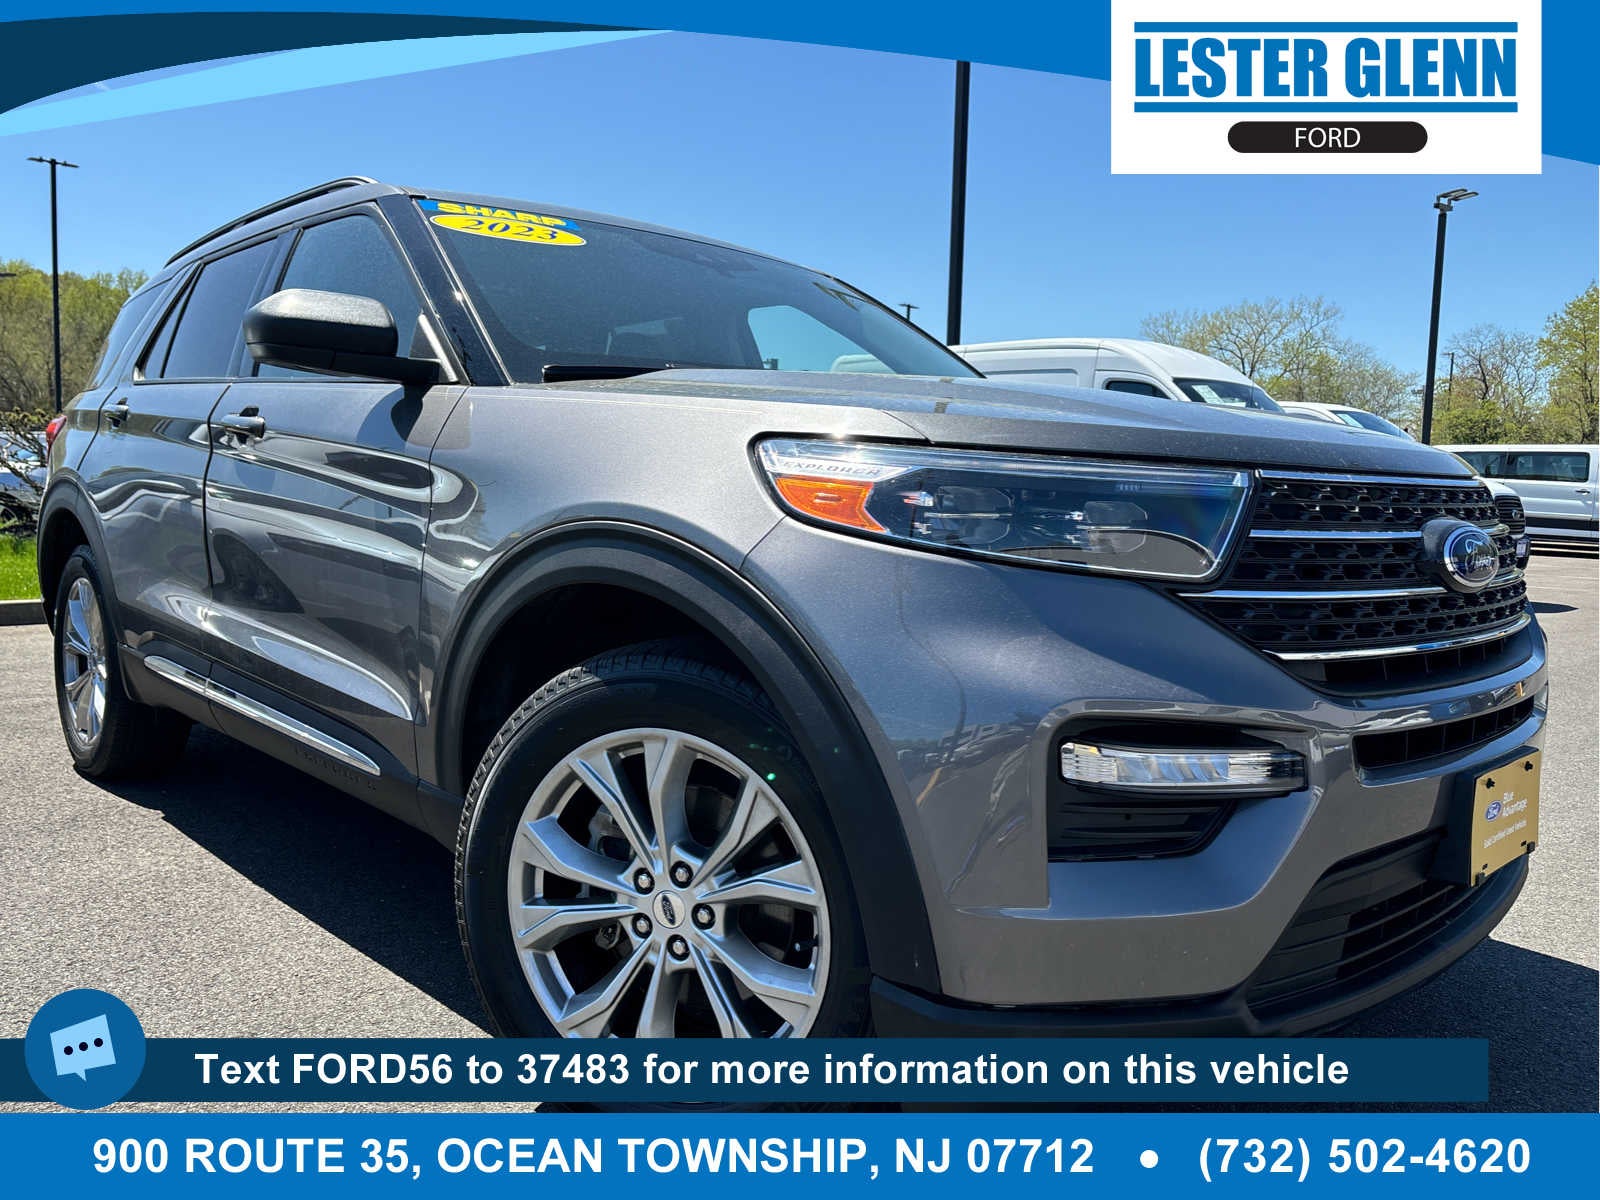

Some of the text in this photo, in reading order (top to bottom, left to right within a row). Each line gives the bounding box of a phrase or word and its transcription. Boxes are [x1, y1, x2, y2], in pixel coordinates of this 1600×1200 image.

[437, 202, 567, 227] SHARP
[461, 218, 558, 241] 2023
[783, 460, 881, 476] EXPLORER
